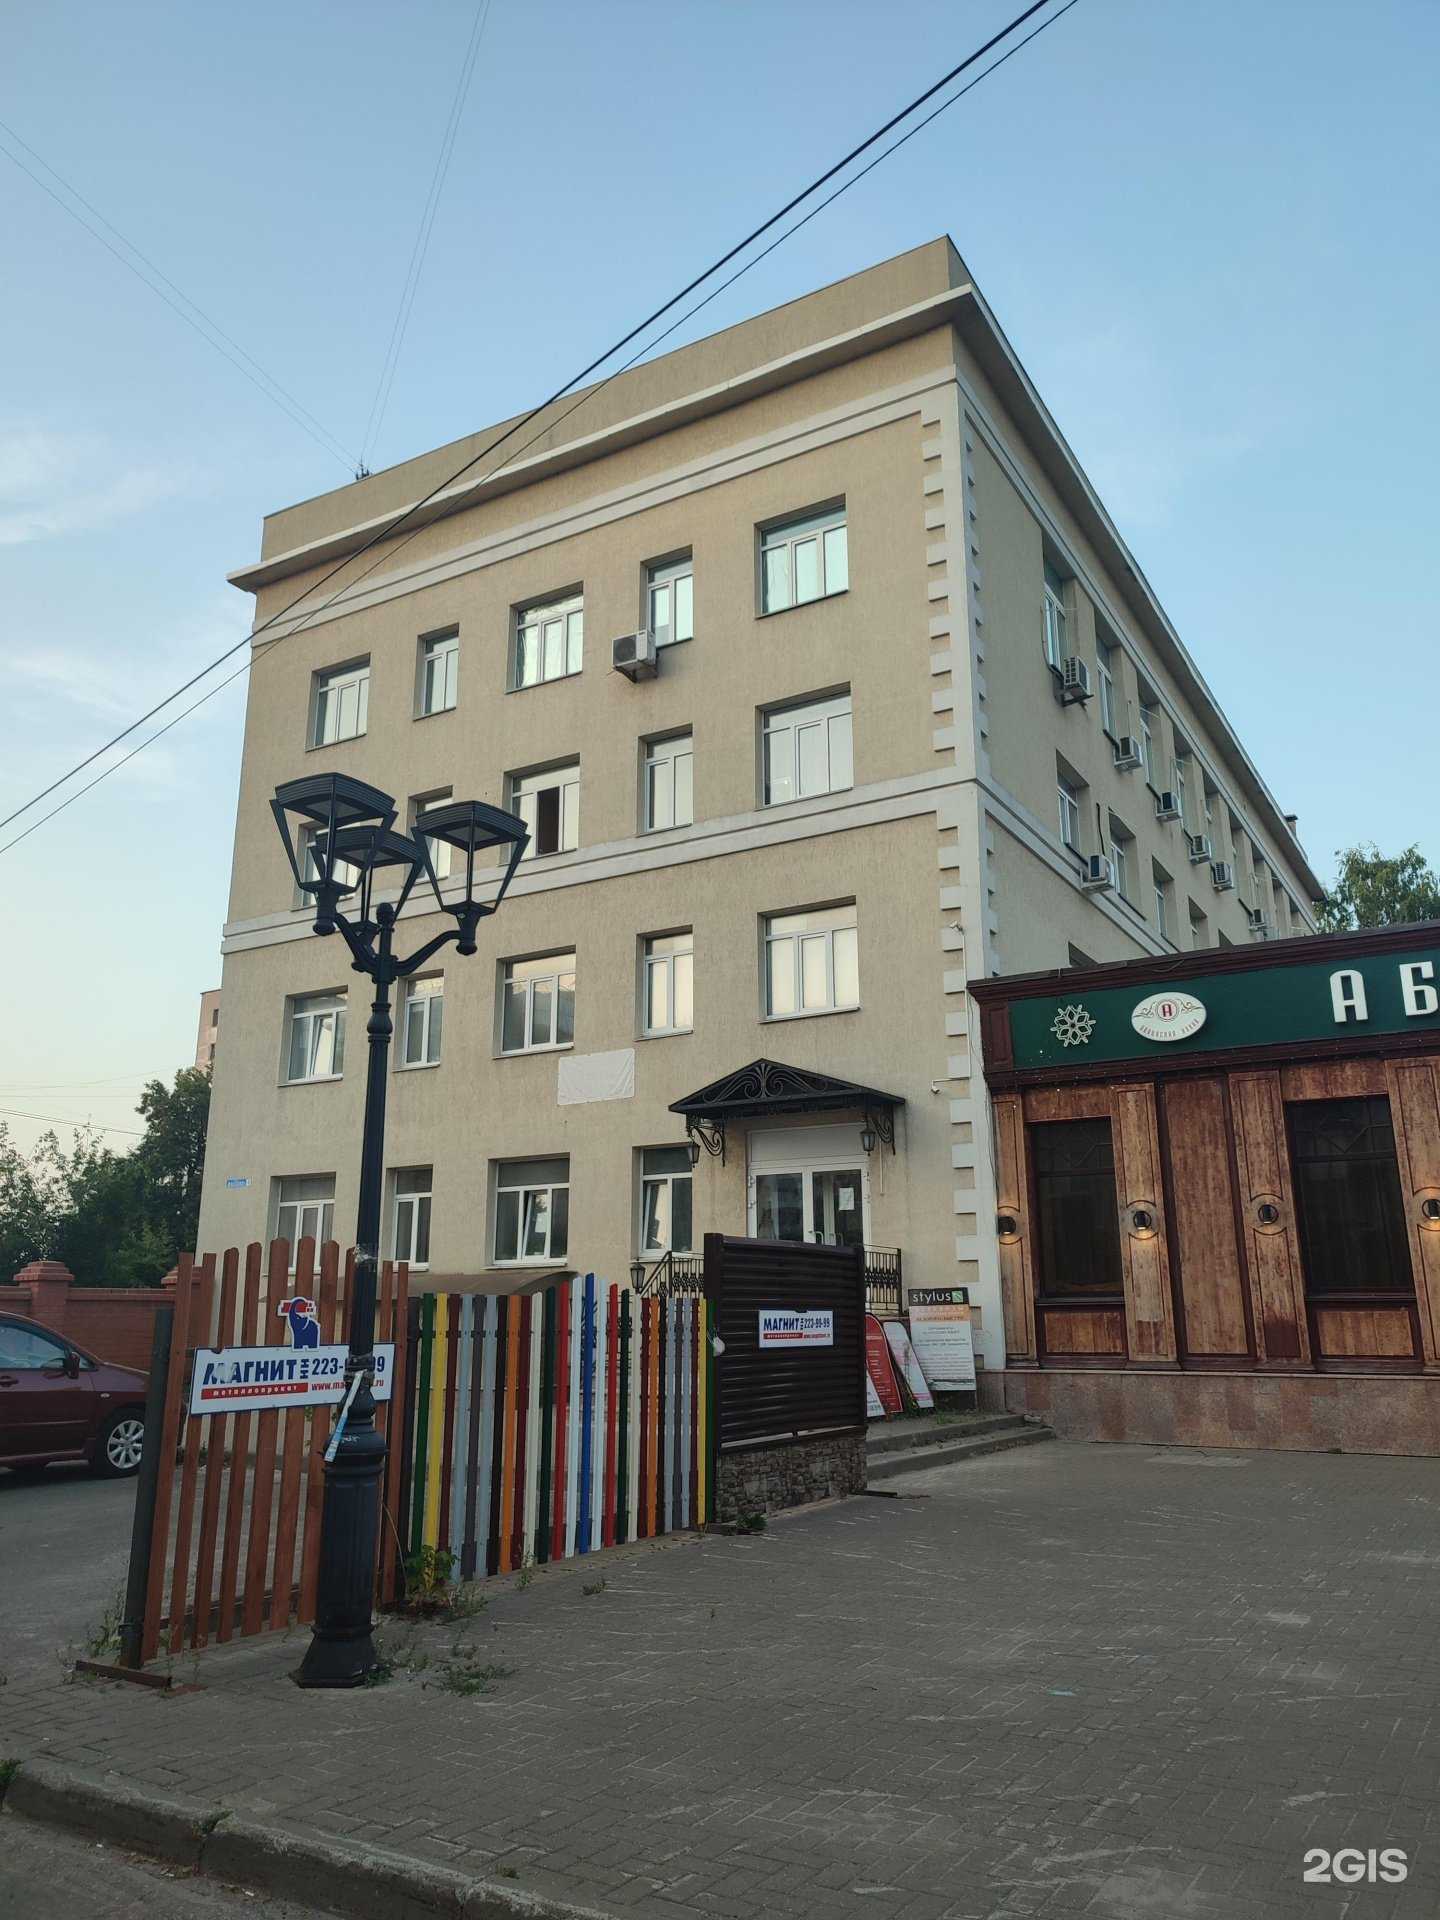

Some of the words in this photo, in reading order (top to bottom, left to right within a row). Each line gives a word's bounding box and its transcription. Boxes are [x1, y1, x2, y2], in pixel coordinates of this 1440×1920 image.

[912, 1290, 951, 1304] stylus
[763, 1317, 799, 1331] МАГНИТ
[312, 1356, 385, 1376] 223--9
[213, 1385, 297, 1396] металлопрокат
